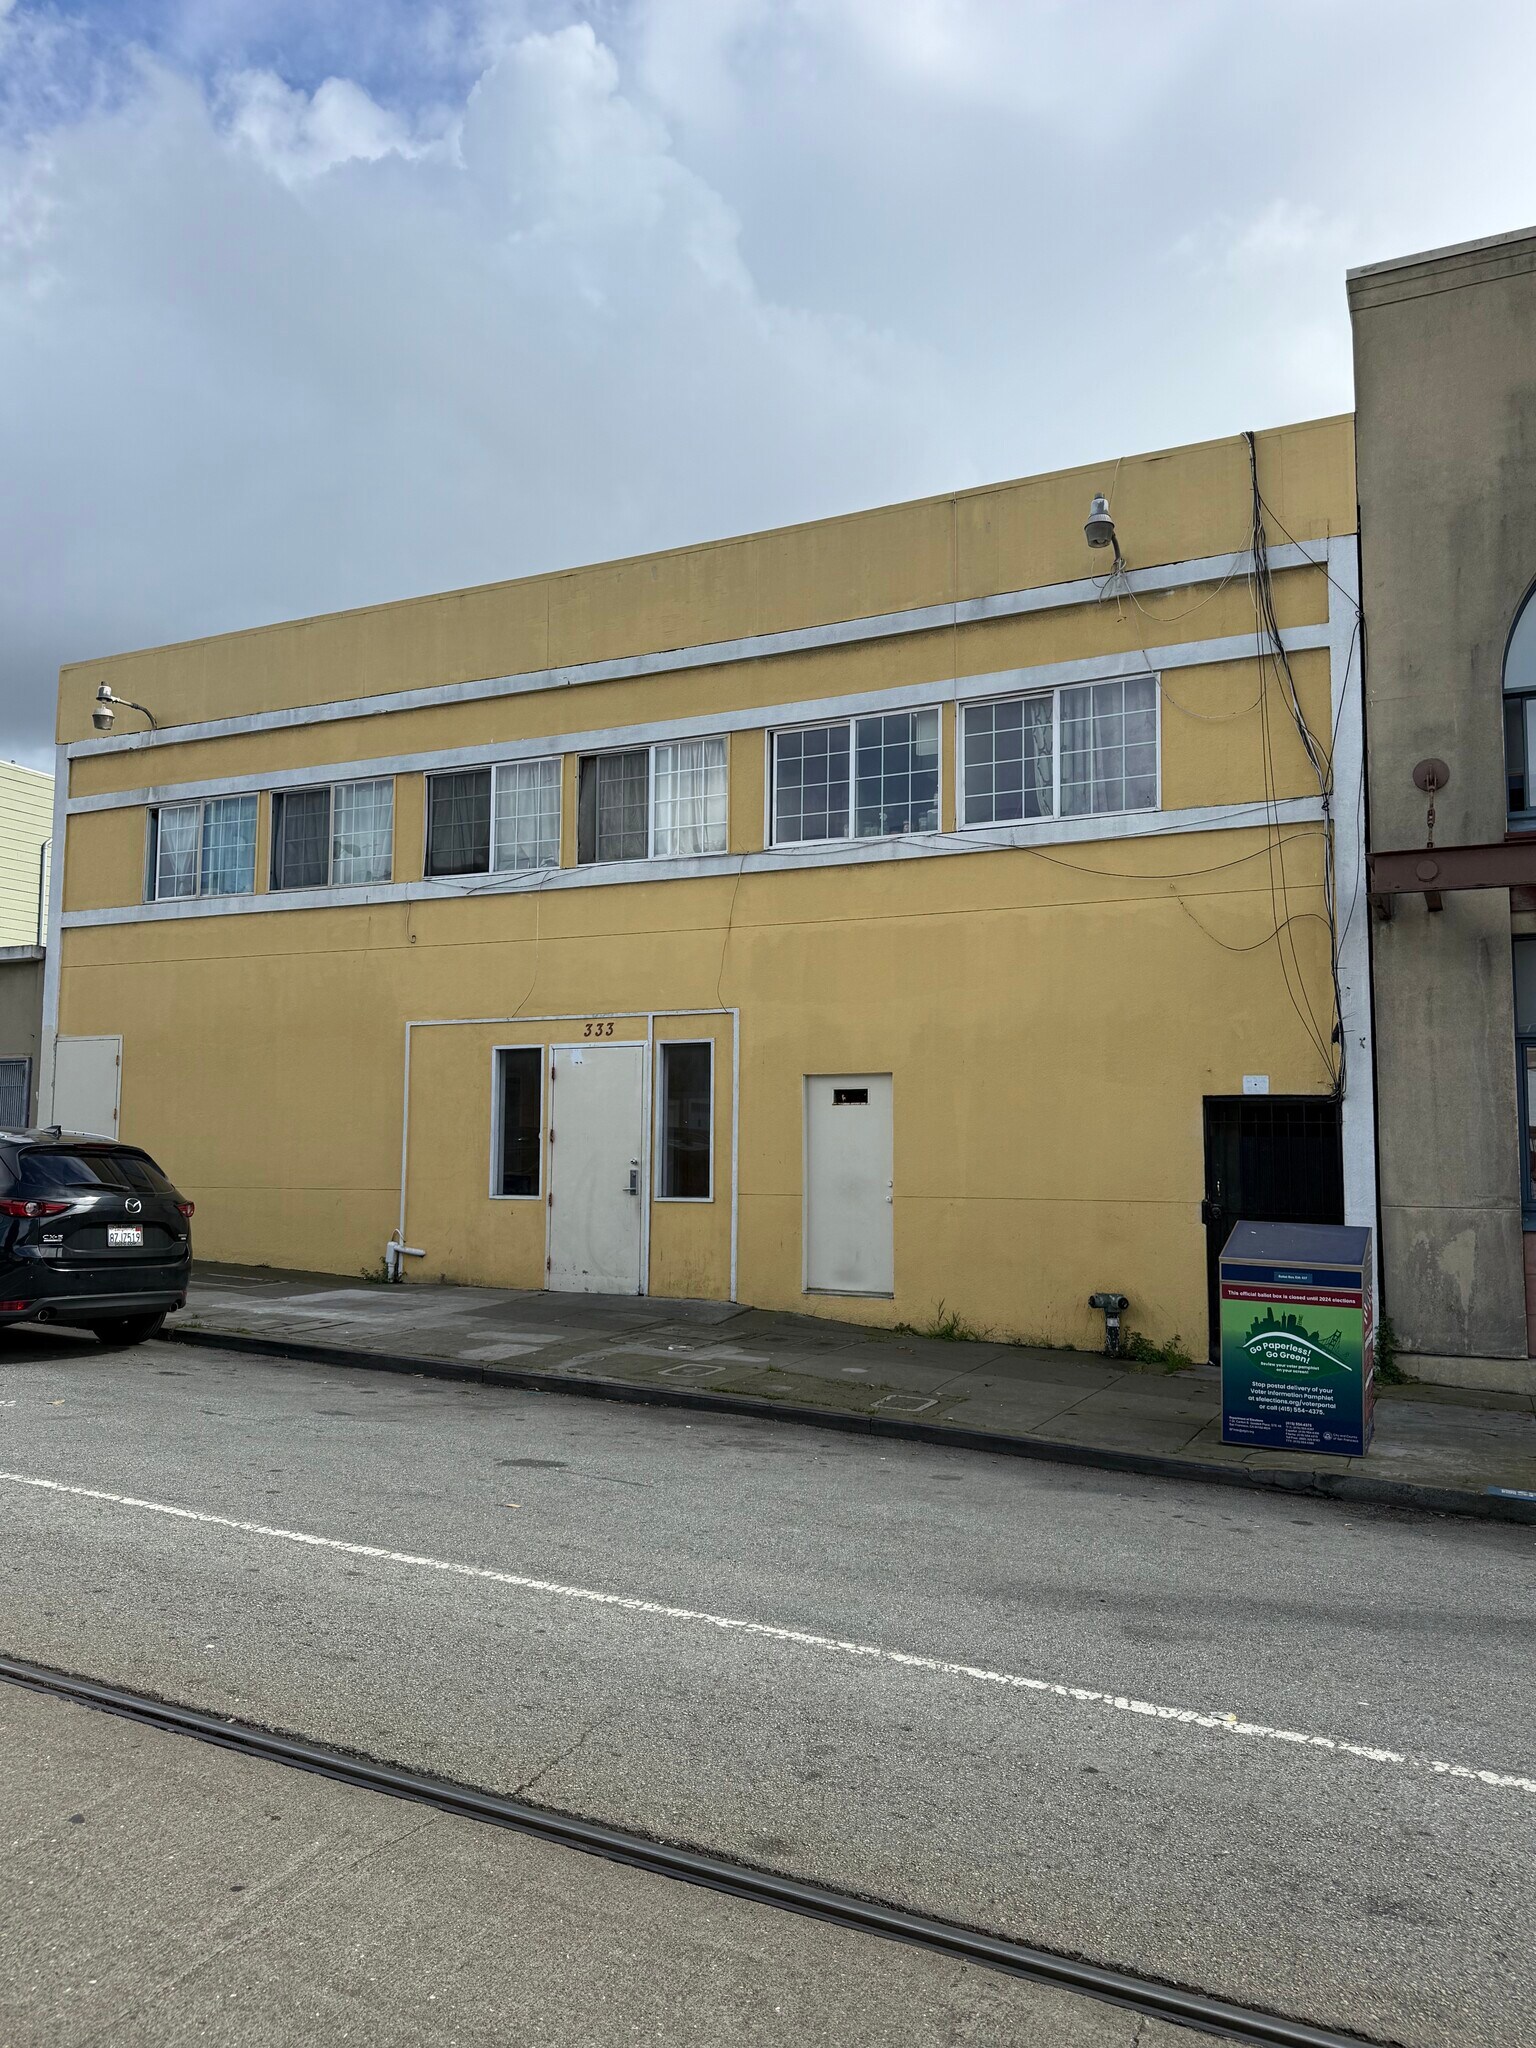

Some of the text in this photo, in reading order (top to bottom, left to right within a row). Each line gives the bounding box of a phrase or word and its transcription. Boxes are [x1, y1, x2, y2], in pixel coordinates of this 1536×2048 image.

[584, 1022, 614, 1037] 333
[1250, 1342, 1312, 1356] Go Paperless!
[1280, 1352, 1310, 1364] Green!
[1268, 1390, 1303, 1398] Information
[1286, 1384, 1310, 1392] delivery
[1256, 1396, 1336, 1409] sfelections.org/voterportal
[1294, 1407, 1325, 1415] 554-4375.
